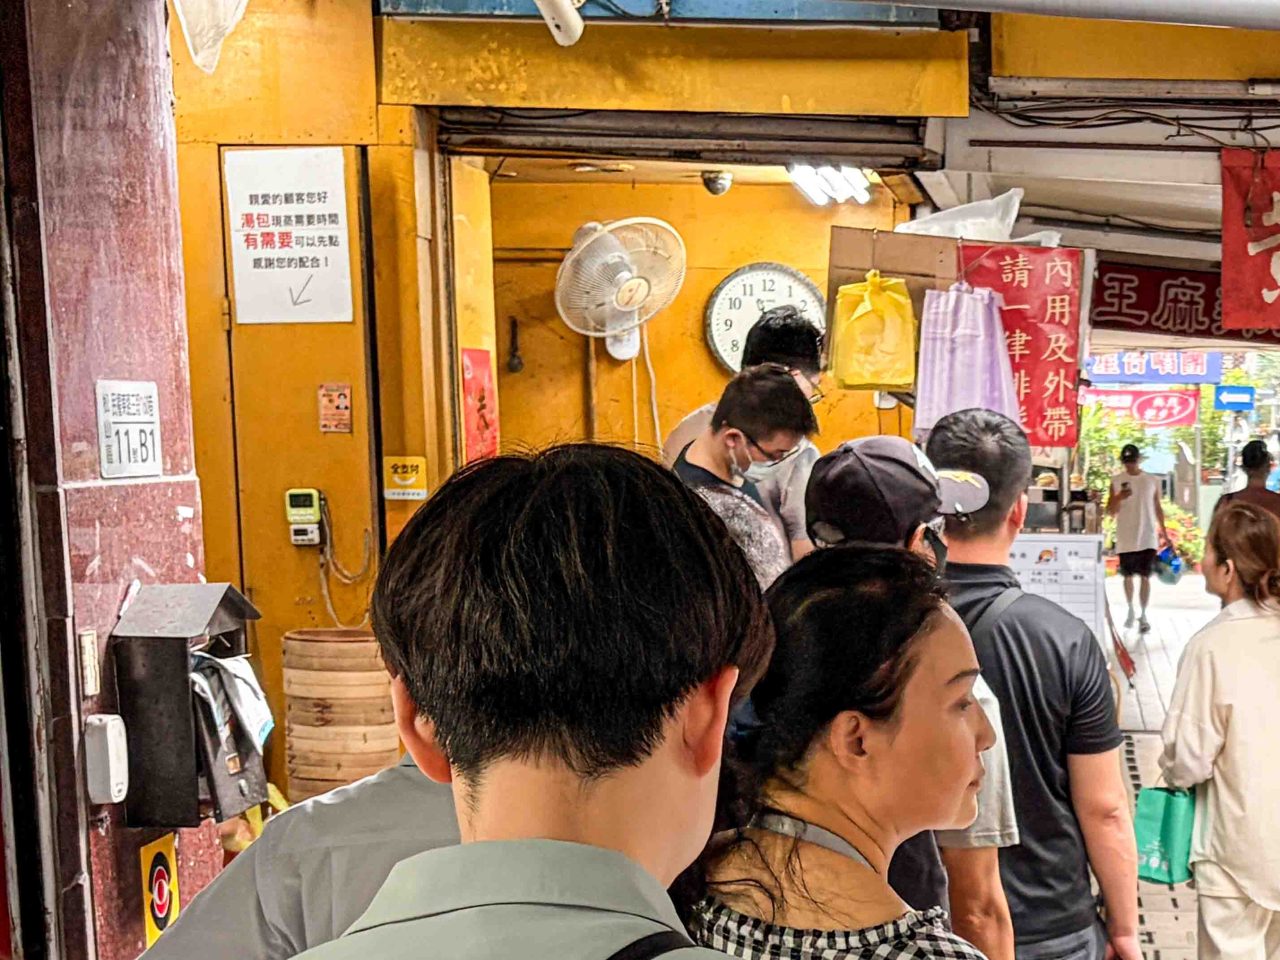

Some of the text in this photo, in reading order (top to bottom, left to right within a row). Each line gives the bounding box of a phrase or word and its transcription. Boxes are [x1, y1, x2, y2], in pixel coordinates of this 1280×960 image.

[249, 192, 329, 206] 親愛的顧客您好
[243, 232, 340, 250] 有需要可以先點
[742, 283, 754, 297] 11
[761, 279, 776, 292] 12
[728, 297, 742, 310] 10
[724, 319, 733, 332] 9
[731, 339, 740, 353] 8
[1040, 256, 1076, 442] 內用及外帶
